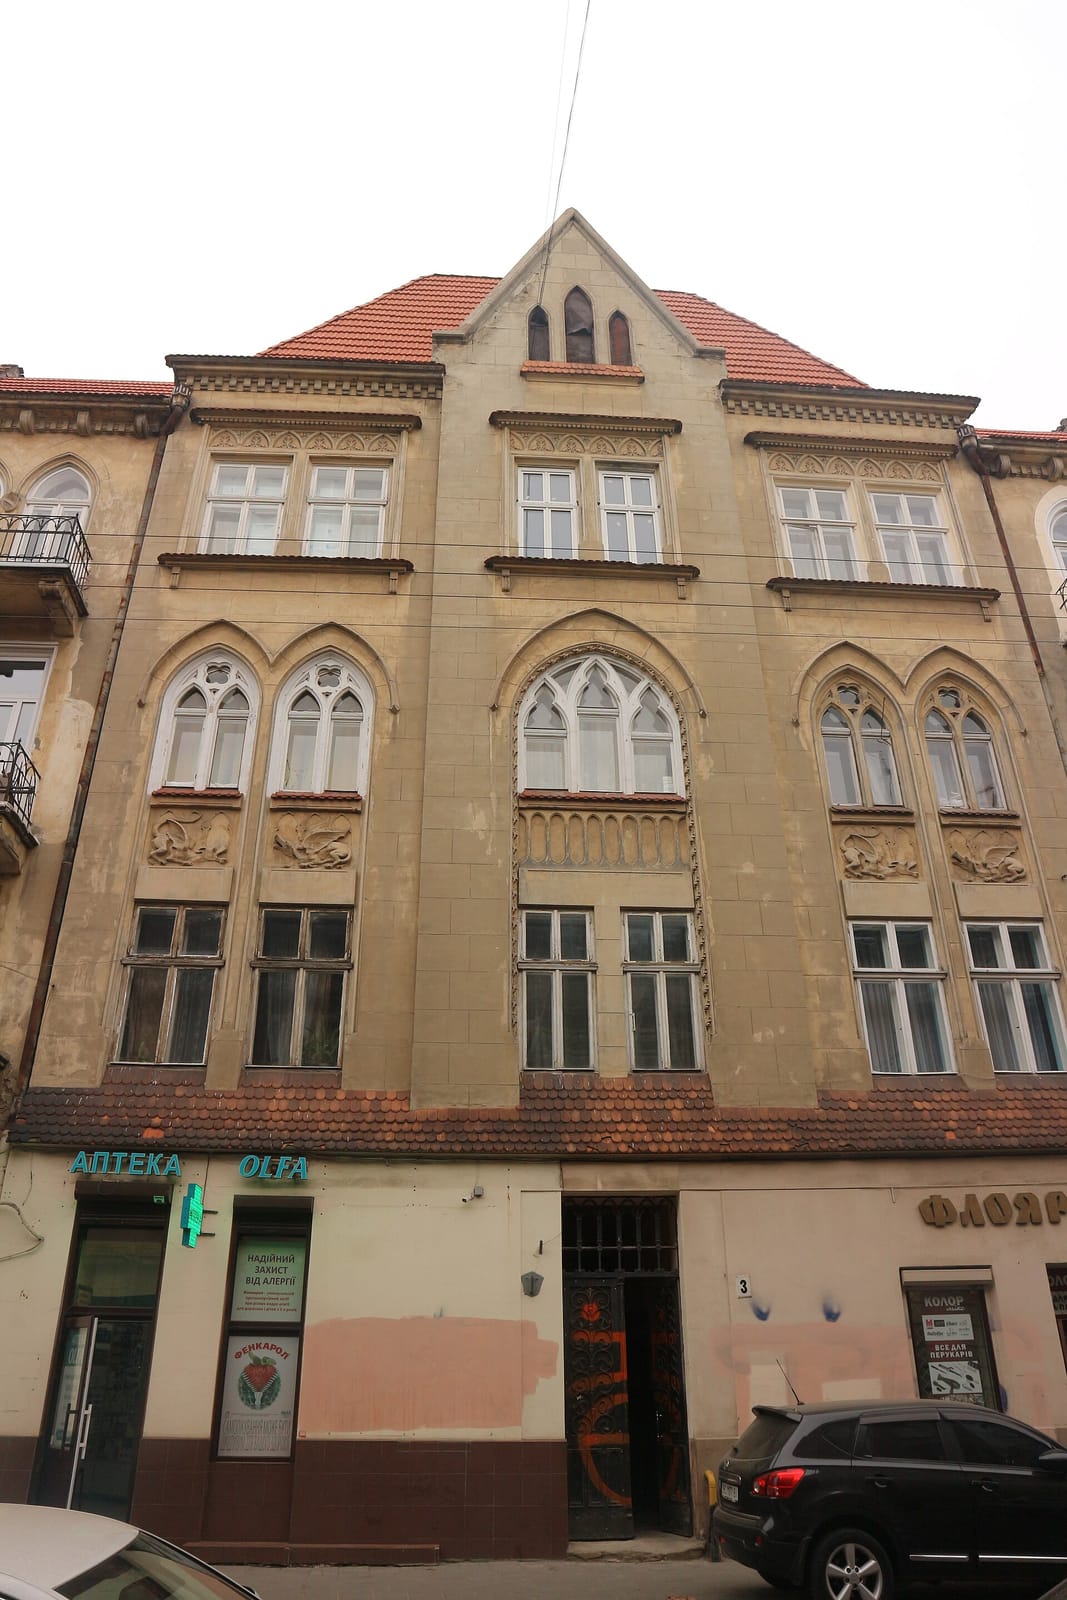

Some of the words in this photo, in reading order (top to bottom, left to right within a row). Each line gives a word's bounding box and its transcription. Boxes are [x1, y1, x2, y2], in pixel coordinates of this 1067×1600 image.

[70, 1151, 182, 1177] АПТЕКА
[239, 1154, 308, 1180] OLFA
[247, 1253, 295, 1264] НАДІЙНИЙ
[254, 1265, 289, 1274] ЗАХИСТ
[245, 1276, 261, 1286] ВІД
[262, 1276, 297, 1286] АЛЕРГІЇ
[739, 1279, 748, 1294] 3
[924, 1296, 964, 1307] КОЛОР
[233, 1342, 290, 1360] ФЕНКАРОЛ
[951, 1343, 967, 1351] ДЛЯ
[930, 1351, 973, 1359] ПЕРУКАРІВ
